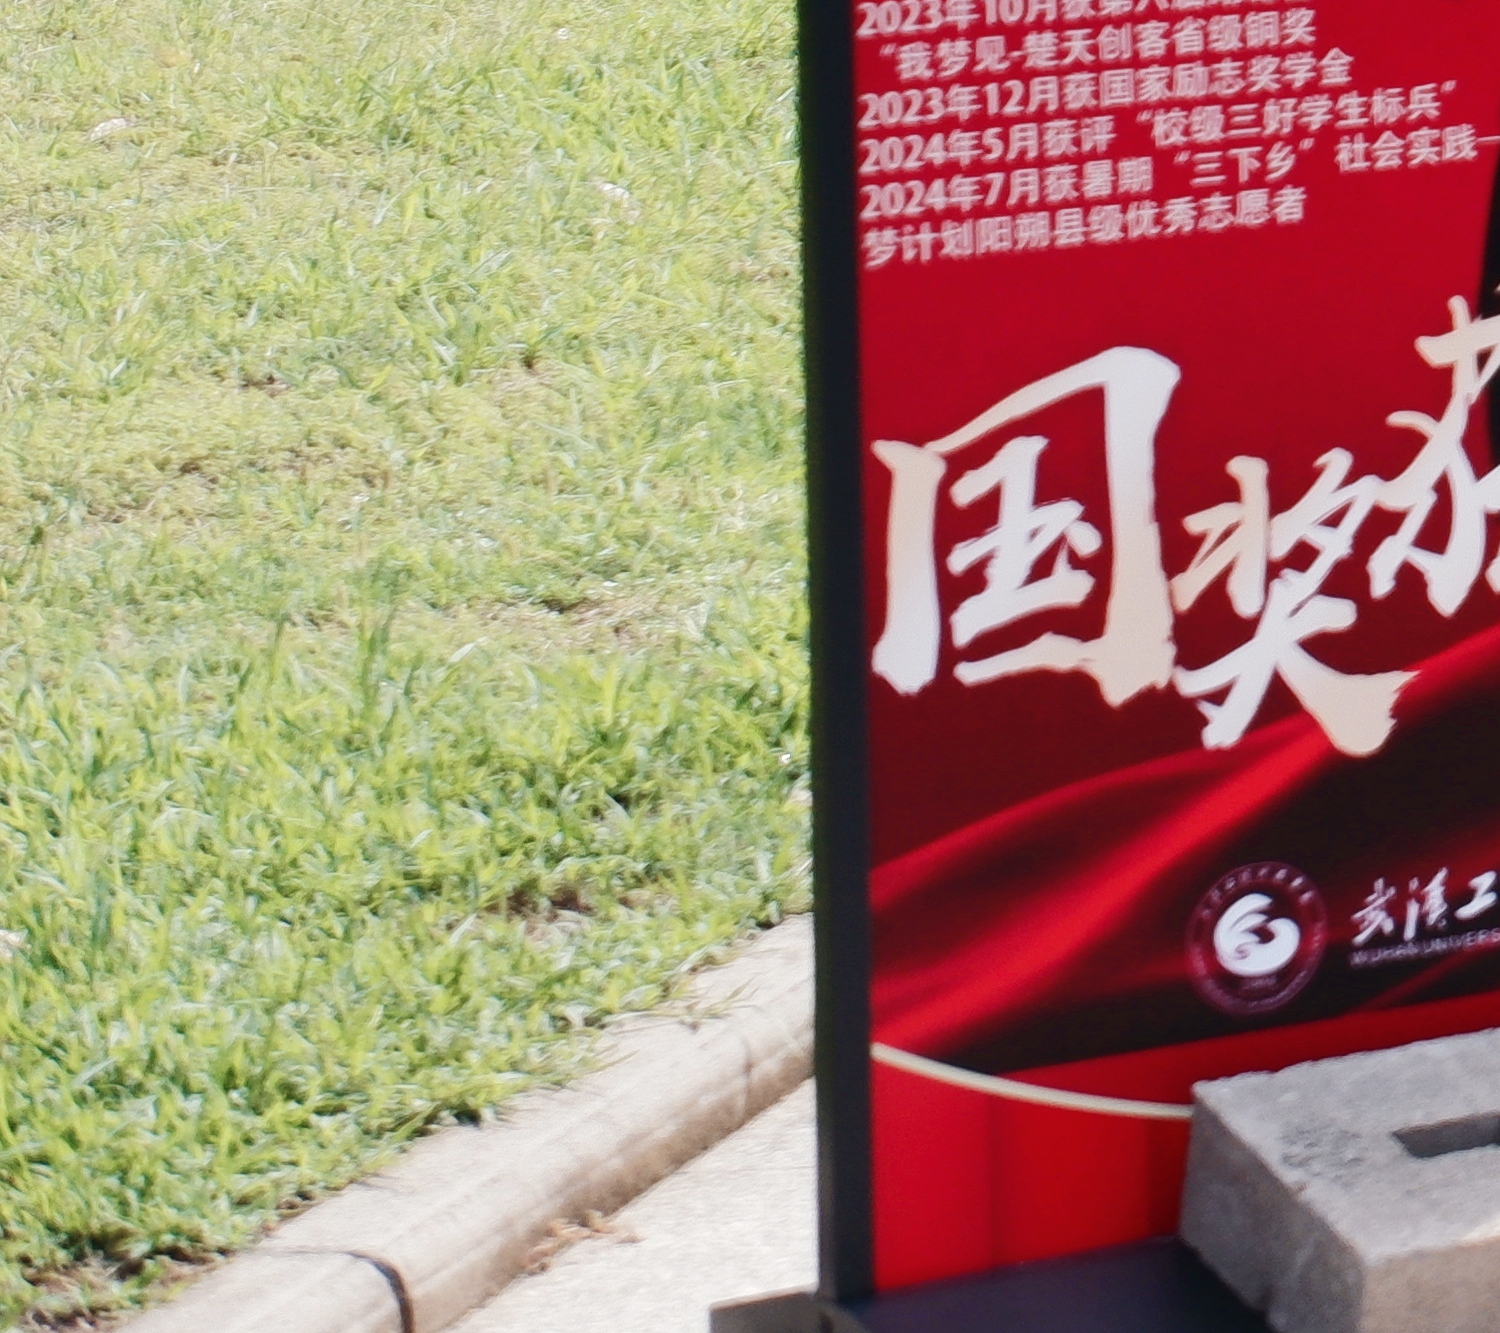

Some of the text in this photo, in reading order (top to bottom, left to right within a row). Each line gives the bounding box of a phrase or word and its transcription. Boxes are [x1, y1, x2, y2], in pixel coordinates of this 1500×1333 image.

[857, 46, 1355, 132] 2023年12月获国家励志奖学金
